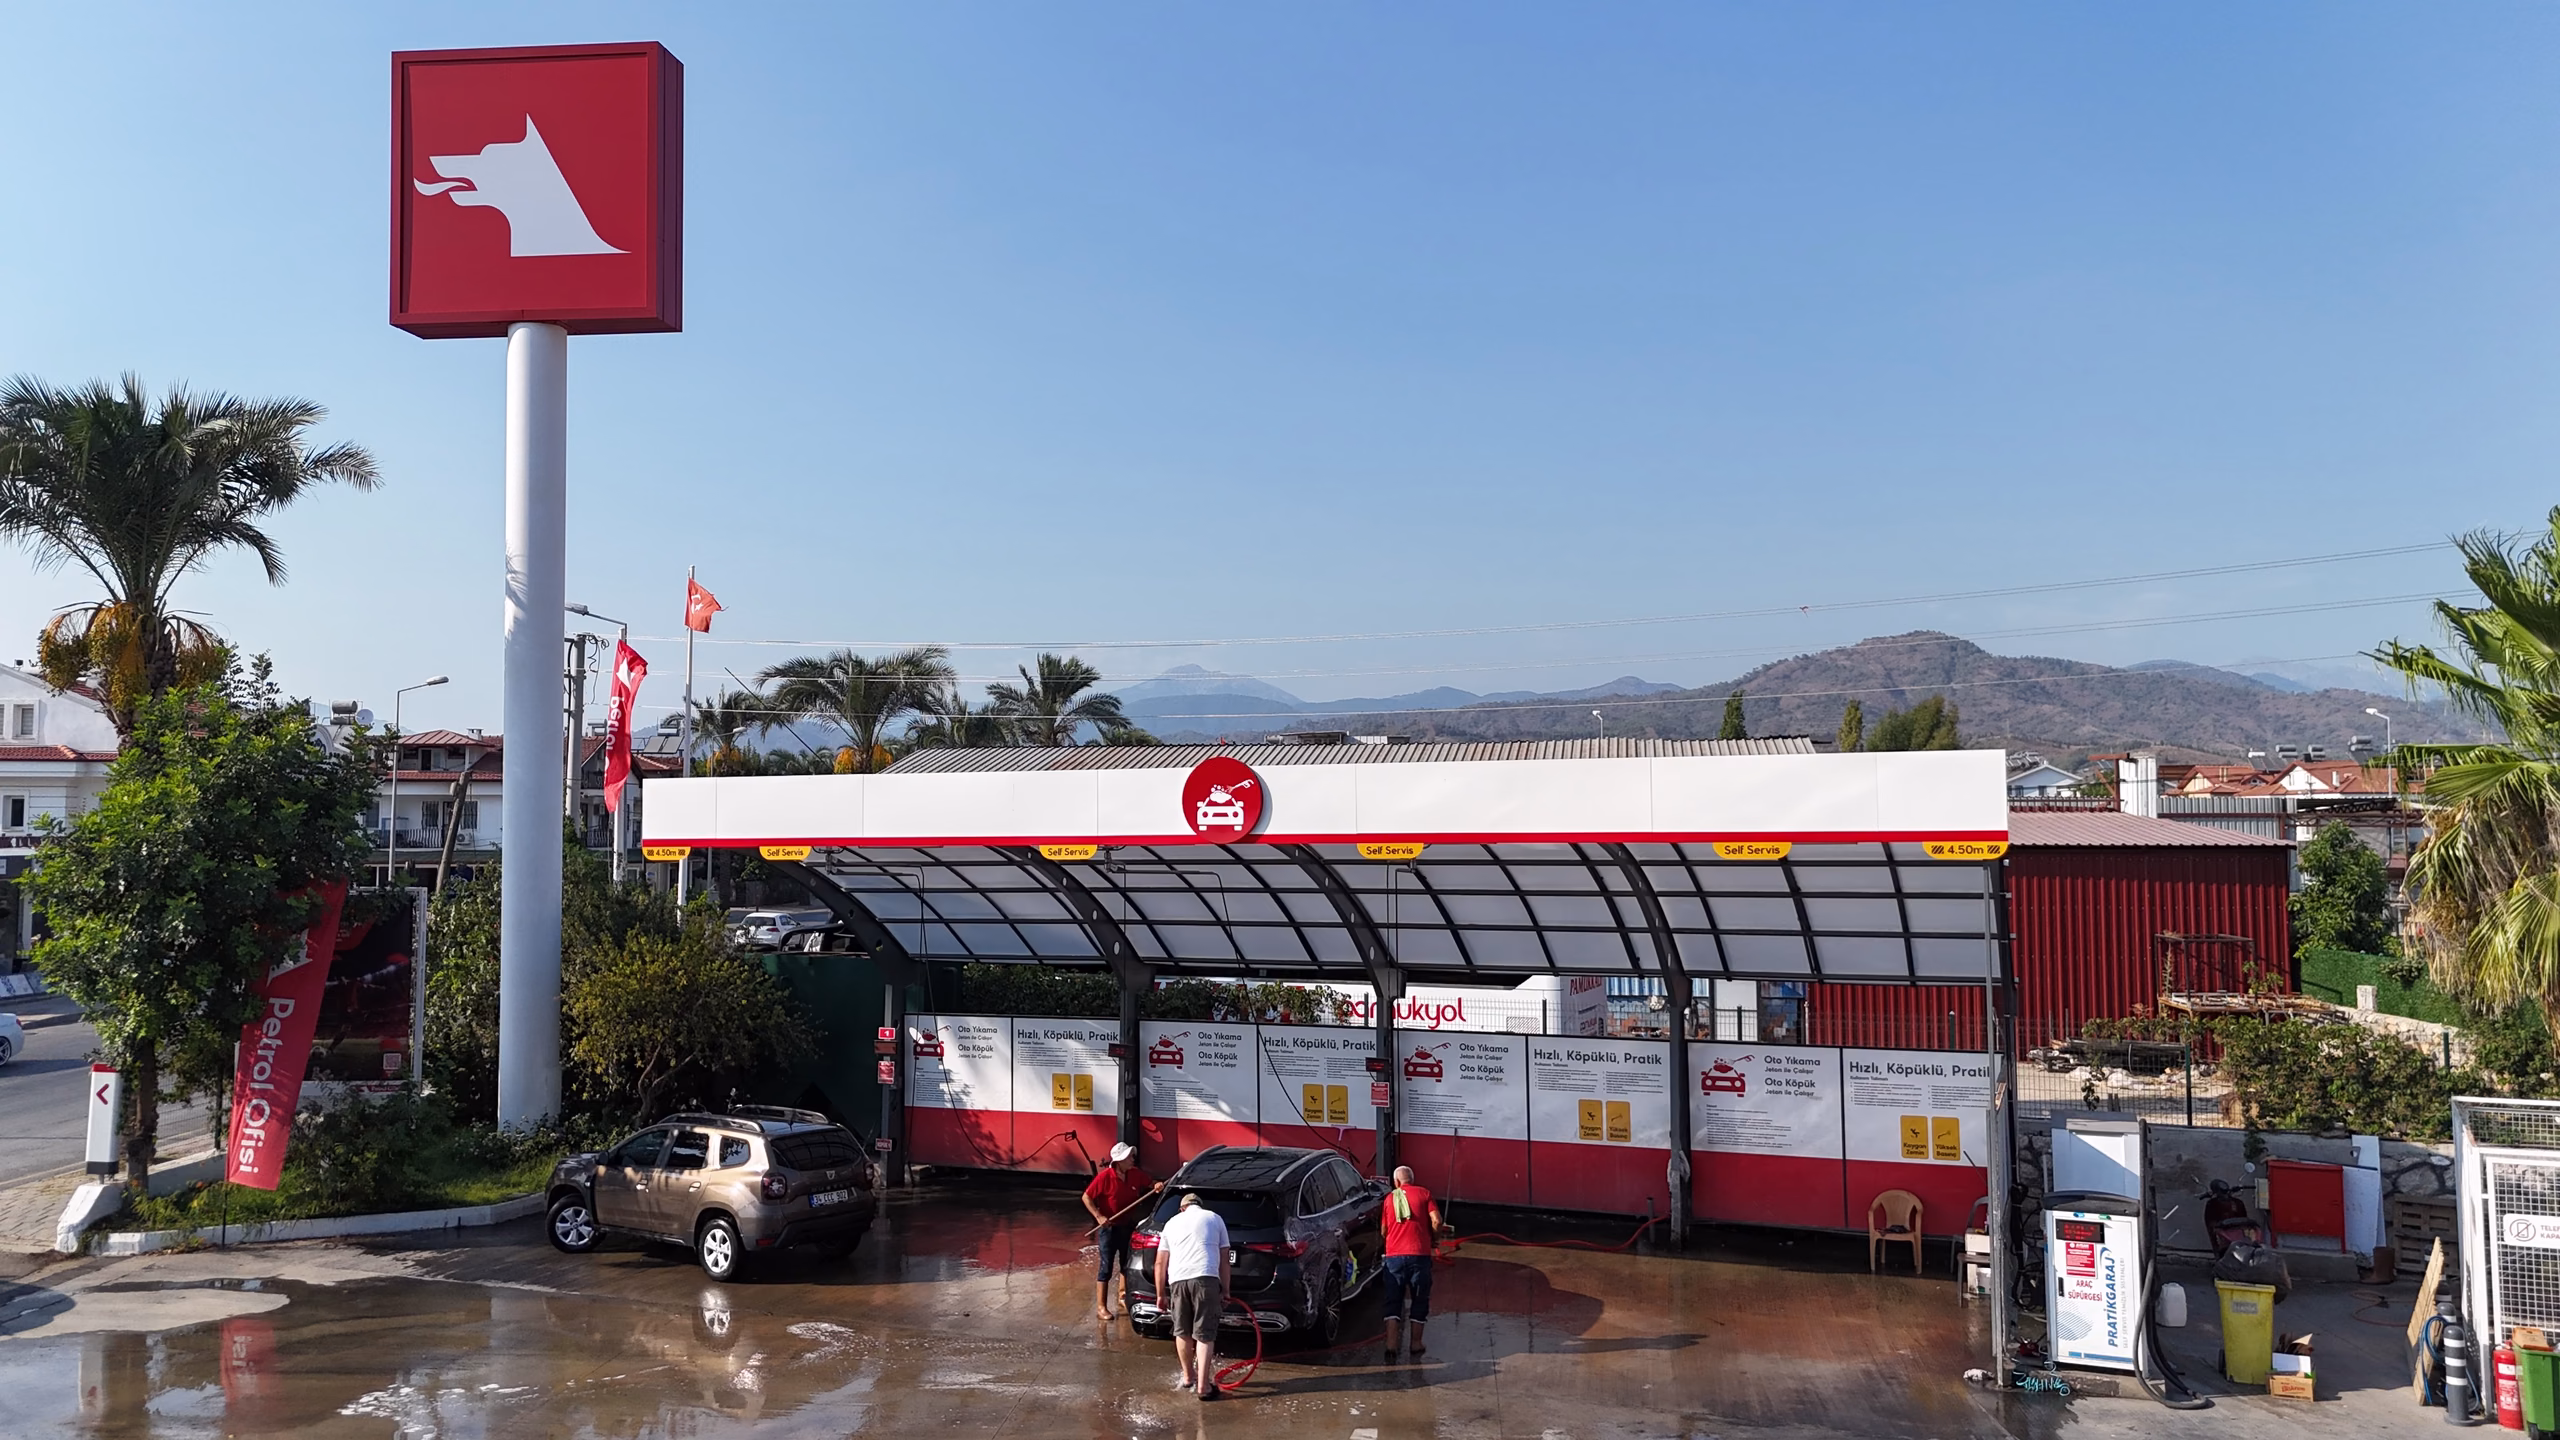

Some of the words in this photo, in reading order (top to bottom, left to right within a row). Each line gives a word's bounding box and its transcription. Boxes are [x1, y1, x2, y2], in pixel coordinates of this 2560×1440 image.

[767, 848, 780, 857] Self
[782, 848, 804, 857] Servis
[1048, 847, 1063, 857] Self
[1065, 847, 1089, 857] Servis
[1366, 846, 1383, 855] Self
[1385, 846, 1414, 855] Servis
[1724, 845, 1744, 855] Self
[1747, 845, 1780, 855] Servis
[1947, 845, 1983, 854] 4.50m
[972, 1026, 998, 1034] Yıkama
[1017, 1029, 1040, 1041] Hızlı,
[1044, 1030, 1085, 1042] Köpüklü,
[1089, 1031, 1118, 1041] Pratik
[1214, 1032, 1242, 1041] Yıkama
[250, 998, 295, 1090] Petrol
[973, 1044, 994, 1054] Köpük
[1264, 1037, 1289, 1048] Hızlı,
[1293, 1038, 1339, 1051] Köpüklü,
[1342, 1040, 1376, 1051] Pratik
[1459, 1042, 1474, 1052] Oto
[1477, 1043, 1509, 1054] Yıkama
[1198, 1052, 1212, 1060] Oto
[1215, 1052, 1238, 1062] Köpük
[1484, 1054, 1503, 1062] Çalışır
[1534, 1049, 1562, 1062] Hızlı,
[1567, 1050, 1620, 1065] Köpüklü,
[1624, 1052, 1662, 1065] Pratik
[1764, 1056, 1781, 1065] Oto
[1784, 1056, 1820, 1066] Yıkama
[1459, 1064, 1475, 1073] Oto
[1478, 1064, 1504, 1075] Köpük
[1793, 1067, 1814, 1075] Çalışır
[1850, 1061, 1882, 1076] Hızlı,
[1887, 1062, 1947, 1078] Köpüklü,
[1952, 1065, 1990, 1078] Prati
[1764, 1078, 1782, 1087] Oto
[1786, 1078, 1816, 1090] Köpük
[1793, 1090, 1814, 1098] Çalışır
[239, 1098, 271, 1172] Ofisi
[1903, 1142, 1926, 1150] Kaygan
[2076, 1280, 2093, 1289] ARAÇ
[2068, 1290, 2102, 1302] SÜPÜRGESİ
[2103, 1257, 2118, 1348] PRATİKGARAJ
